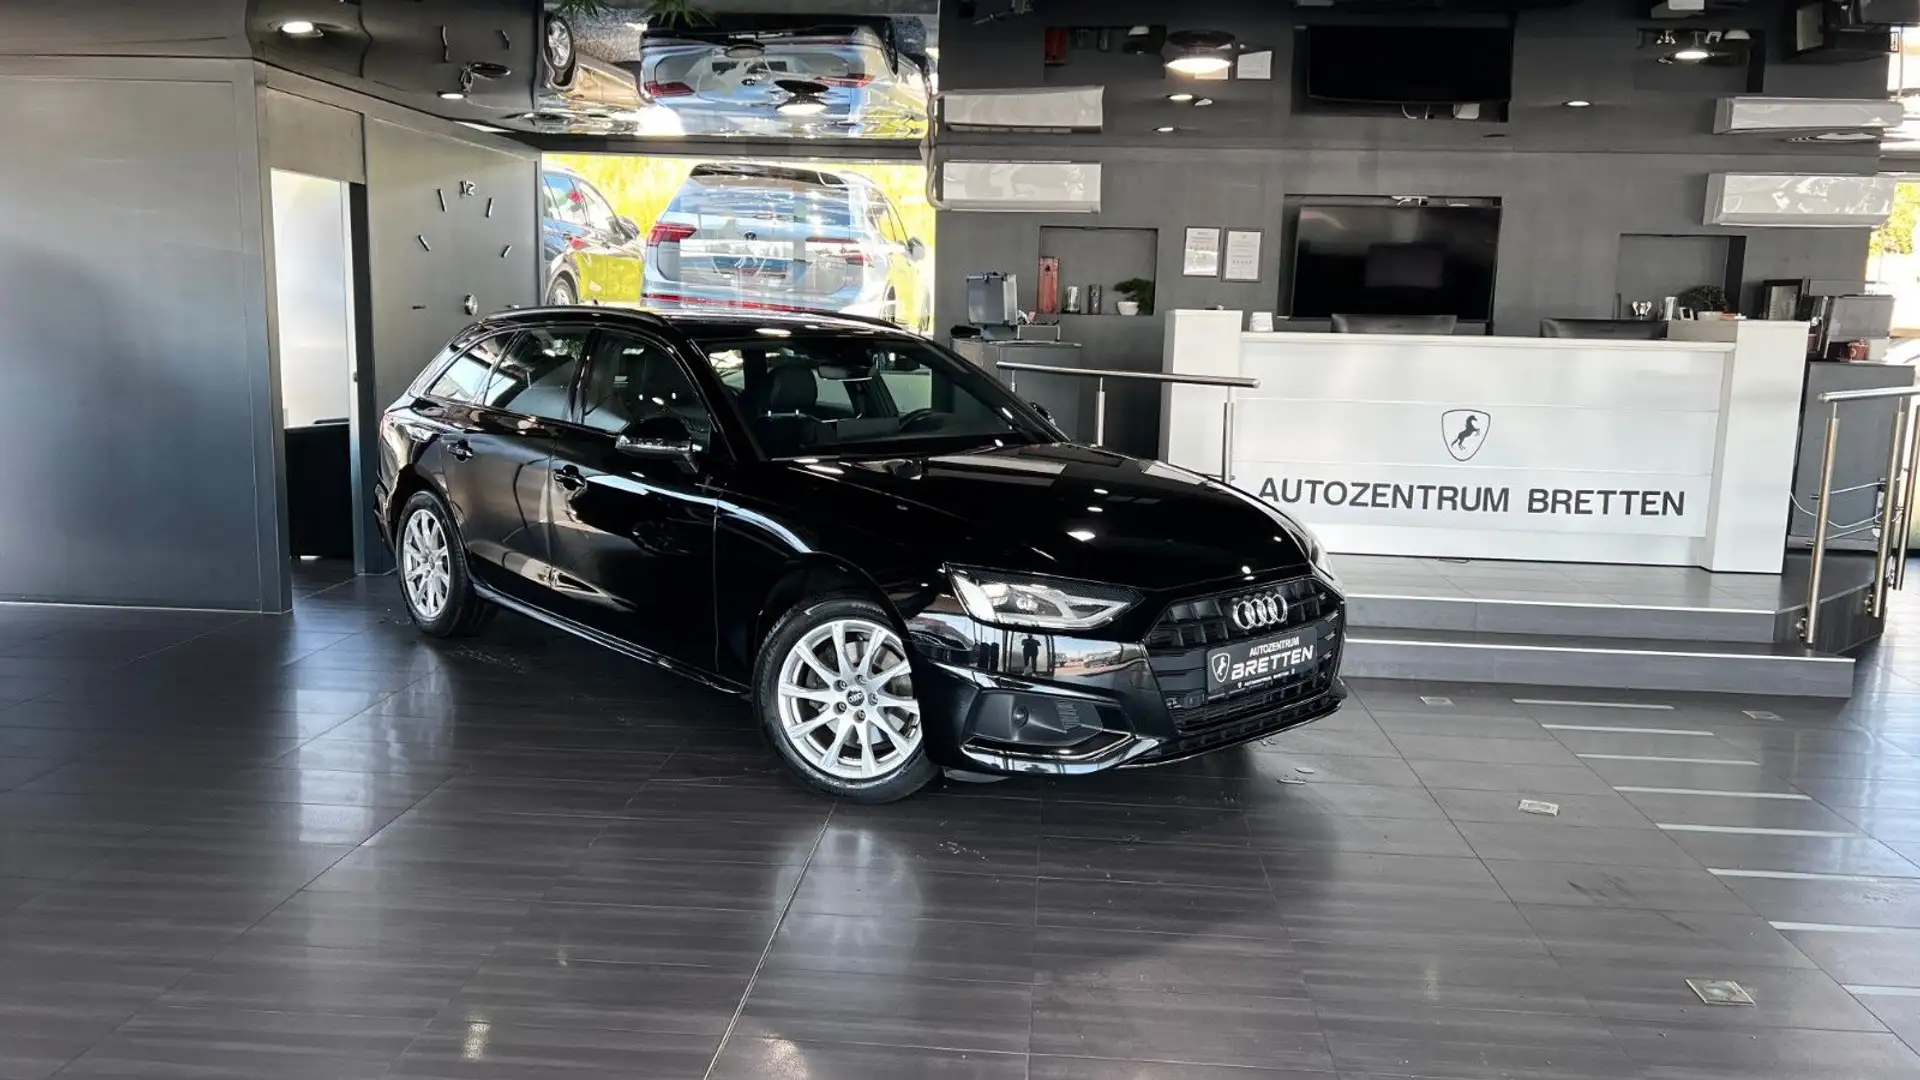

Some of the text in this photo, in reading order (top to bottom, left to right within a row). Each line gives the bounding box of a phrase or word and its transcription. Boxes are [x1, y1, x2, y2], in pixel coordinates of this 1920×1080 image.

[1258, 477, 1685, 516] AUTOZENTRUM BRETTEN
[1231, 644, 1314, 680] BRETTEN
[1249, 636, 1300, 657] AUTOZENTRUM
